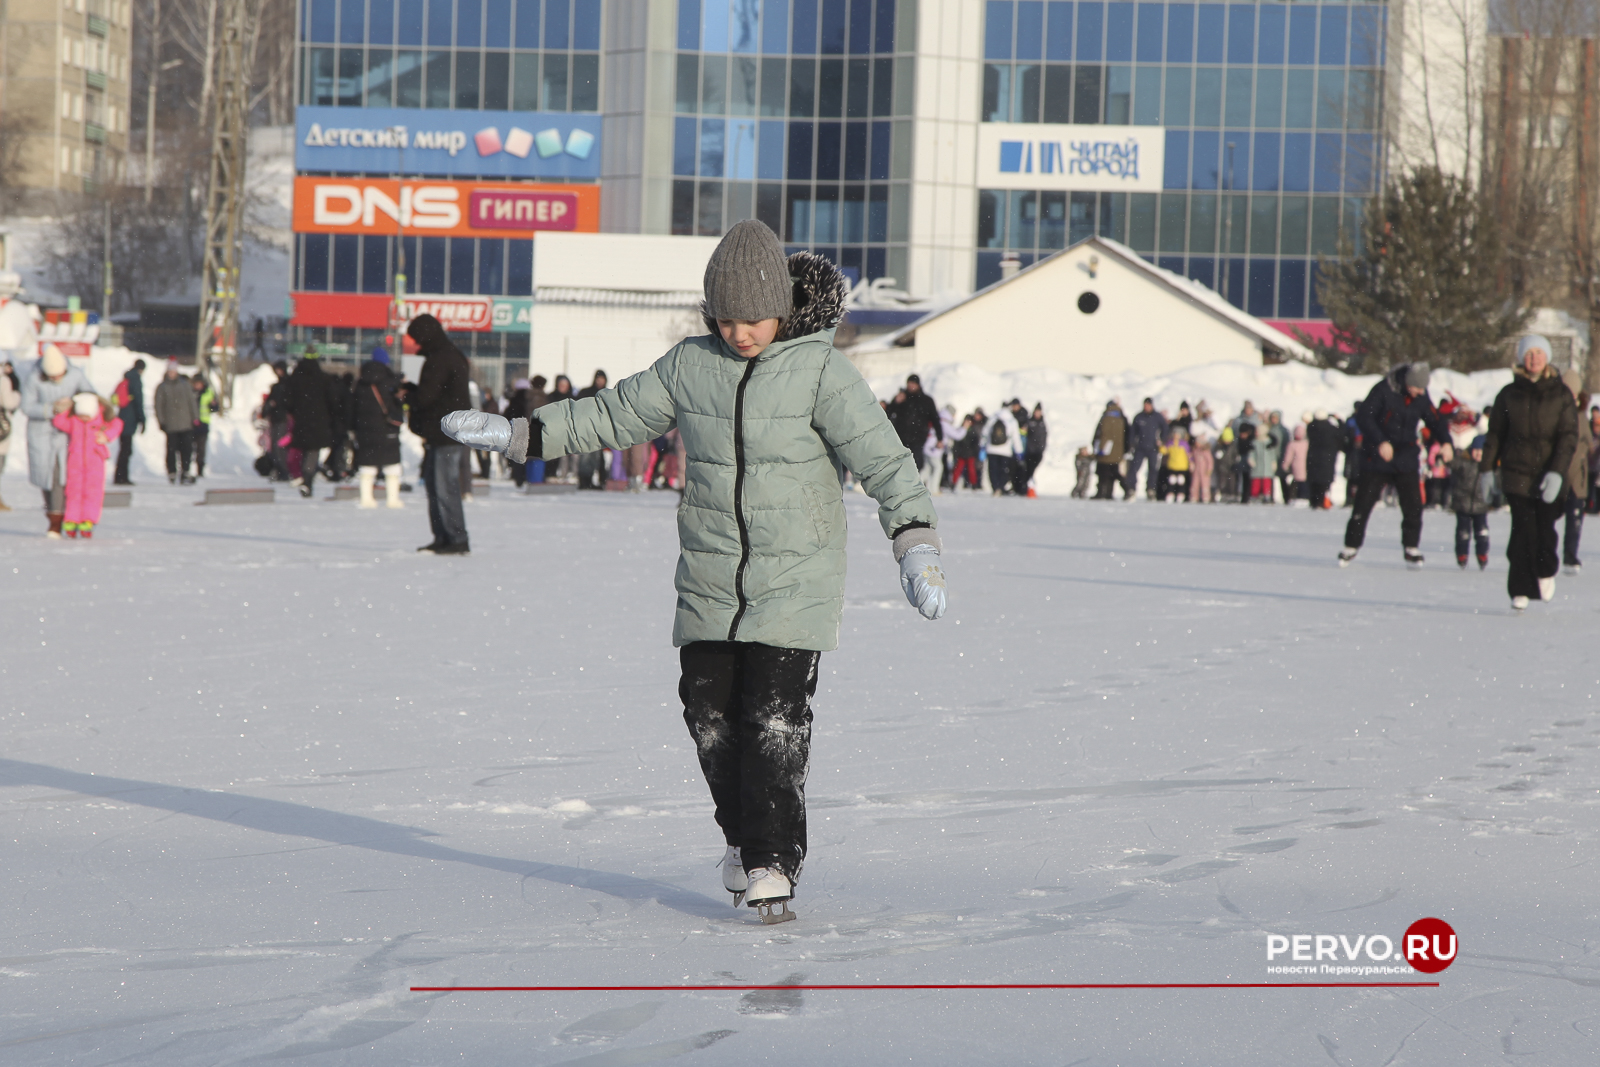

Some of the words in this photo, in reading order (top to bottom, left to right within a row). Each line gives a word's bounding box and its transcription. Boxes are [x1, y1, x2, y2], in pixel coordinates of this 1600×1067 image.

[304, 123, 408, 148] Детский
[413, 129, 467, 157] мир
[1070, 136, 1139, 158] ЧИТАЙ
[1070, 158, 1139, 180] ГОРОД
[313, 184, 461, 228] DNS
[479, 198, 568, 222] ГИПЕР
